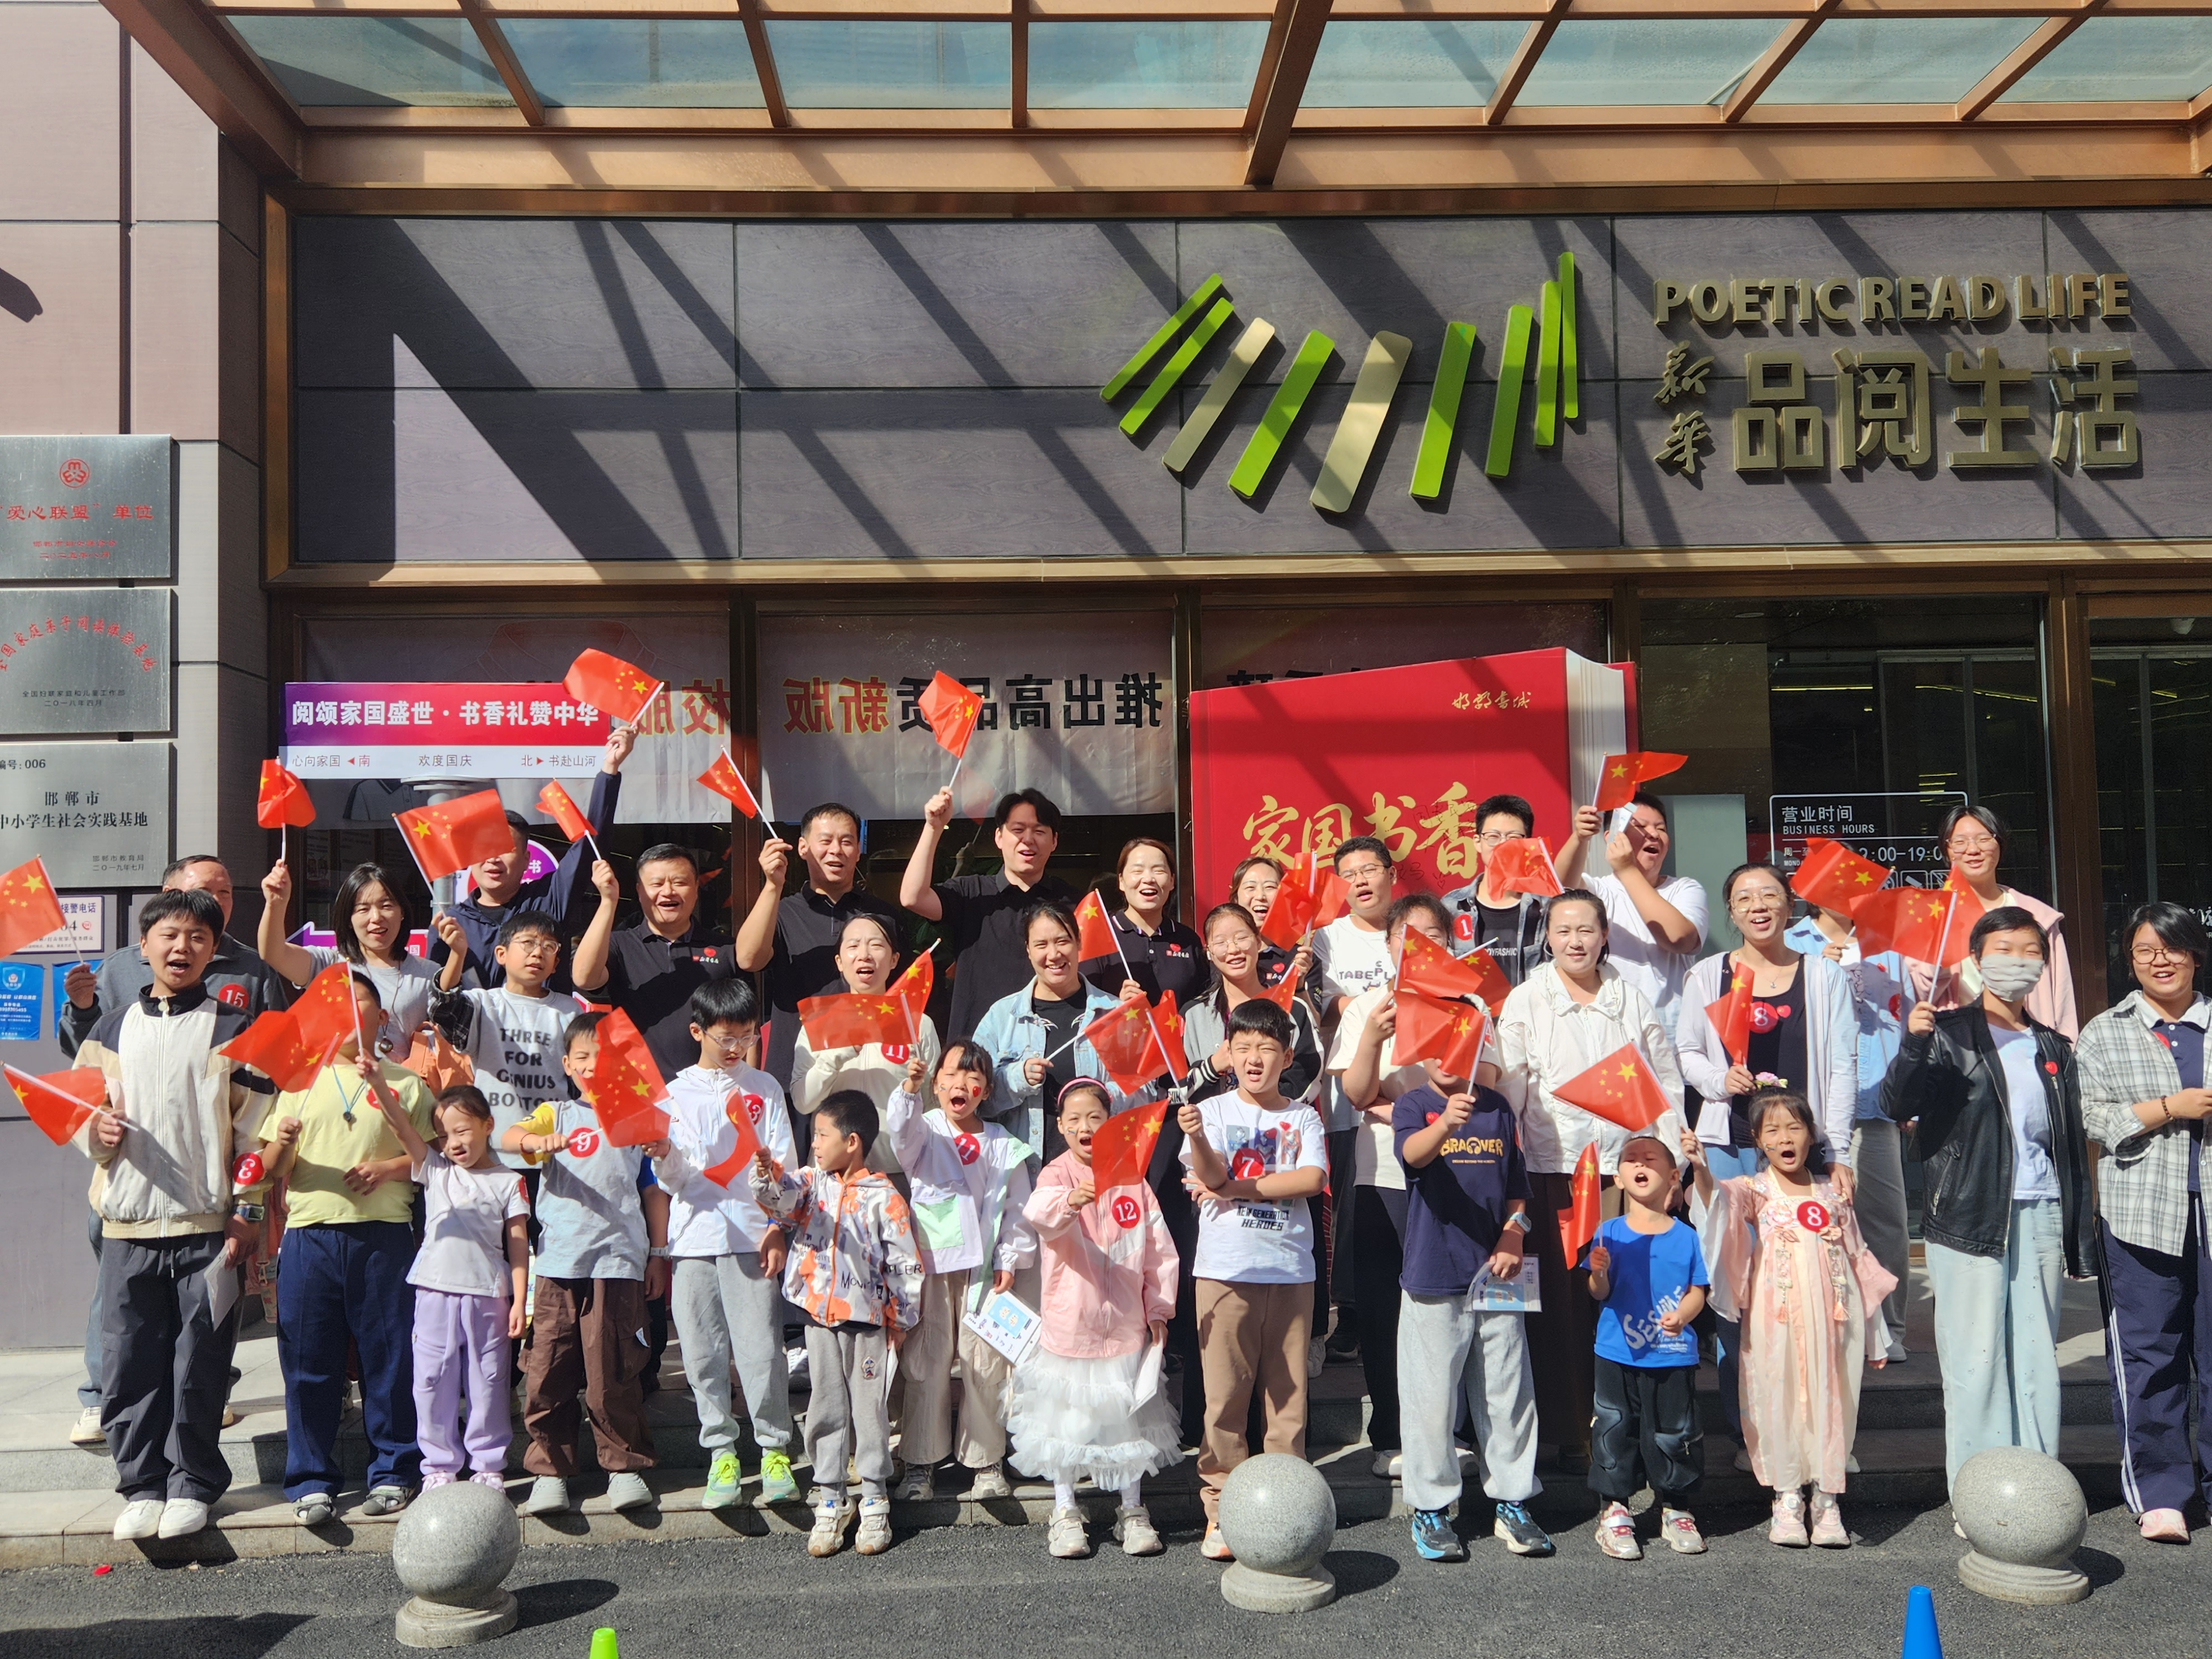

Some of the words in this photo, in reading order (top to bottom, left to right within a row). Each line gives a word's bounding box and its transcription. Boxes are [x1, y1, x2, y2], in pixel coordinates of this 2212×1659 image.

[1654, 277, 1850, 325] POETIC
[1859, 276, 2006, 322] READ
[2015, 274, 2131, 319] LIFE
[1732, 346, 2139, 471] 品阅生活
[113, 504, 154, 520] 单位
[292, 755, 341, 768] 心向家国
[358, 755, 371, 767] 南
[418, 754, 472, 767] 欢度国庆
[521, 755, 533, 766] 北
[549, 755, 596, 767] 书赴山河
[45, 791, 100, 806] 邯郸市
[0, 812, 148, 829] 中小学生社会实践基地
[1782, 805, 1853, 823] 营业时间
[1243, 781, 1478, 879] 家国书香
[1783, 825, 1835, 835] BUSINESS
[1842, 823, 1875, 834] HOURS
[1754, 1007, 1768, 1026] 8
[499, 1027, 551, 1046] THREE
[504, 1051, 542, 1066] FOR
[1242, 1156, 1255, 1178] 7
[1116, 1201, 1137, 1222] 12
[1807, 1206, 1822, 1226] 8
[1241, 1218, 1284, 1231] HEROES
